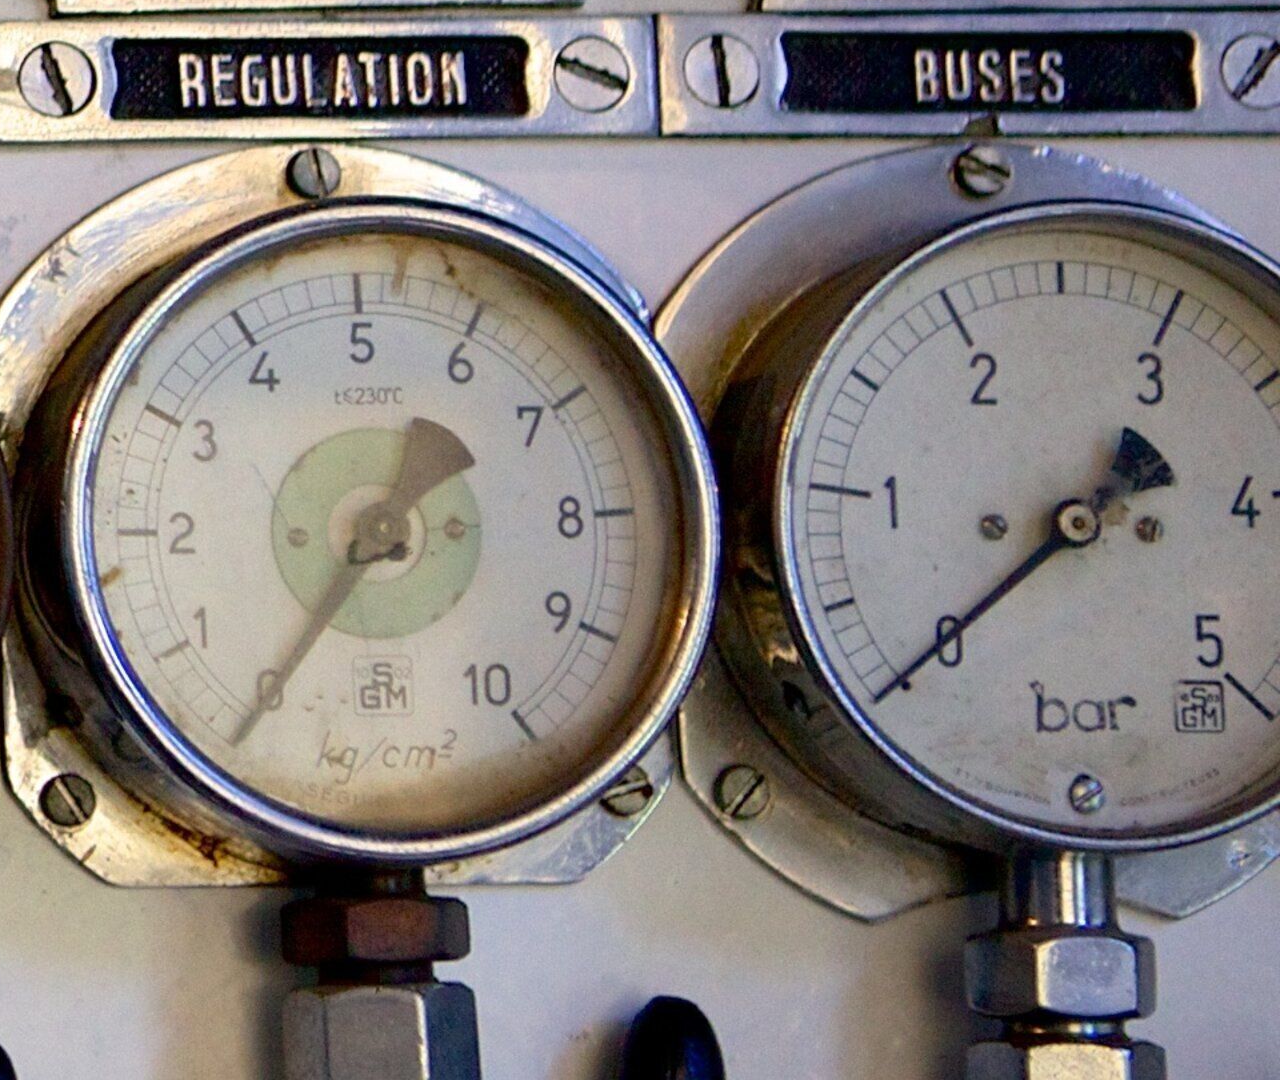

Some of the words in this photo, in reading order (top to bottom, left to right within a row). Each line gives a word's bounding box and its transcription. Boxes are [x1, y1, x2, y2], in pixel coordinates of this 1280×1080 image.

[178, 51, 468, 108] REGULATION
[915, 48, 1066, 104] BUSES
[349, 323, 374, 363] 5
[447, 343, 474, 383] 6
[249, 351, 280, 391] 4
[970, 354, 998, 405] 2
[1136, 353, 1164, 405] 3
[193, 421, 217, 461] 3
[517, 406, 543, 446] 7
[558, 497, 583, 538] 8
[882, 476, 898, 529] 1
[1231, 475, 1260, 528] 4
[169, 513, 195, 554] 2
[193, 607, 207, 648] 1
[545, 591, 571, 632] 9
[936, 615, 963, 667] 0
[1195, 615, 1224, 668] 5
[256, 669, 284, 711] 0
[463, 664, 512, 705] 10
[1029, 680, 1137, 733] bar
